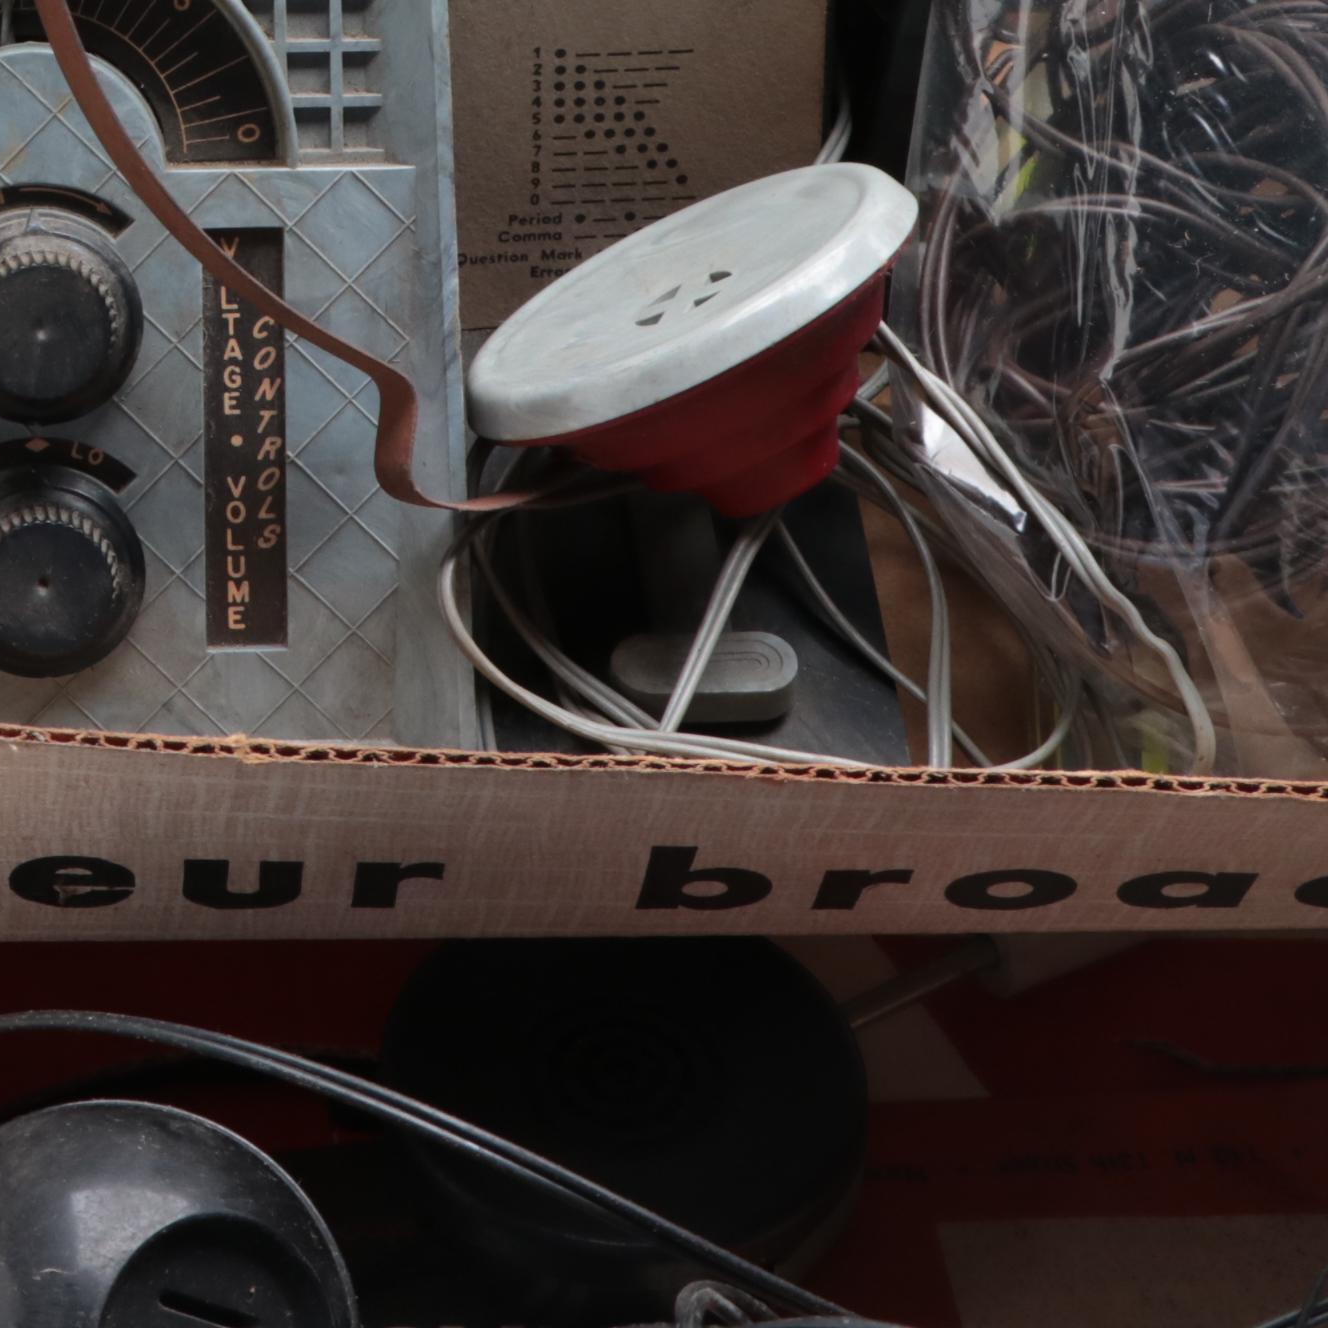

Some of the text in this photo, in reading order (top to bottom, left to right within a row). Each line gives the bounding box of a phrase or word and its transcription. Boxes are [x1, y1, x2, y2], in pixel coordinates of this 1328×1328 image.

[534, 47, 540, 58] 1
[533, 64, 542, 76] 2
[533, 80, 541, 92] 3
[532, 96, 541, 108] 4
[532, 112, 541, 124] 5
[532, 130, 542, 142] 6
[533, 144, 541, 156] 7
[532, 161, 540, 173] 8
[531, 178, 540, 189] 9
[530, 194, 539, 205] 0
[509, 213, 562, 226] Period
[498, 231, 562, 243] Comma
[541, 248, 581, 260] Mark
[220, 238, 250, 630] VLTAGE VOLUME
[252, 315, 281, 549] CONTROLS
[71, 441, 104, 465] LO
